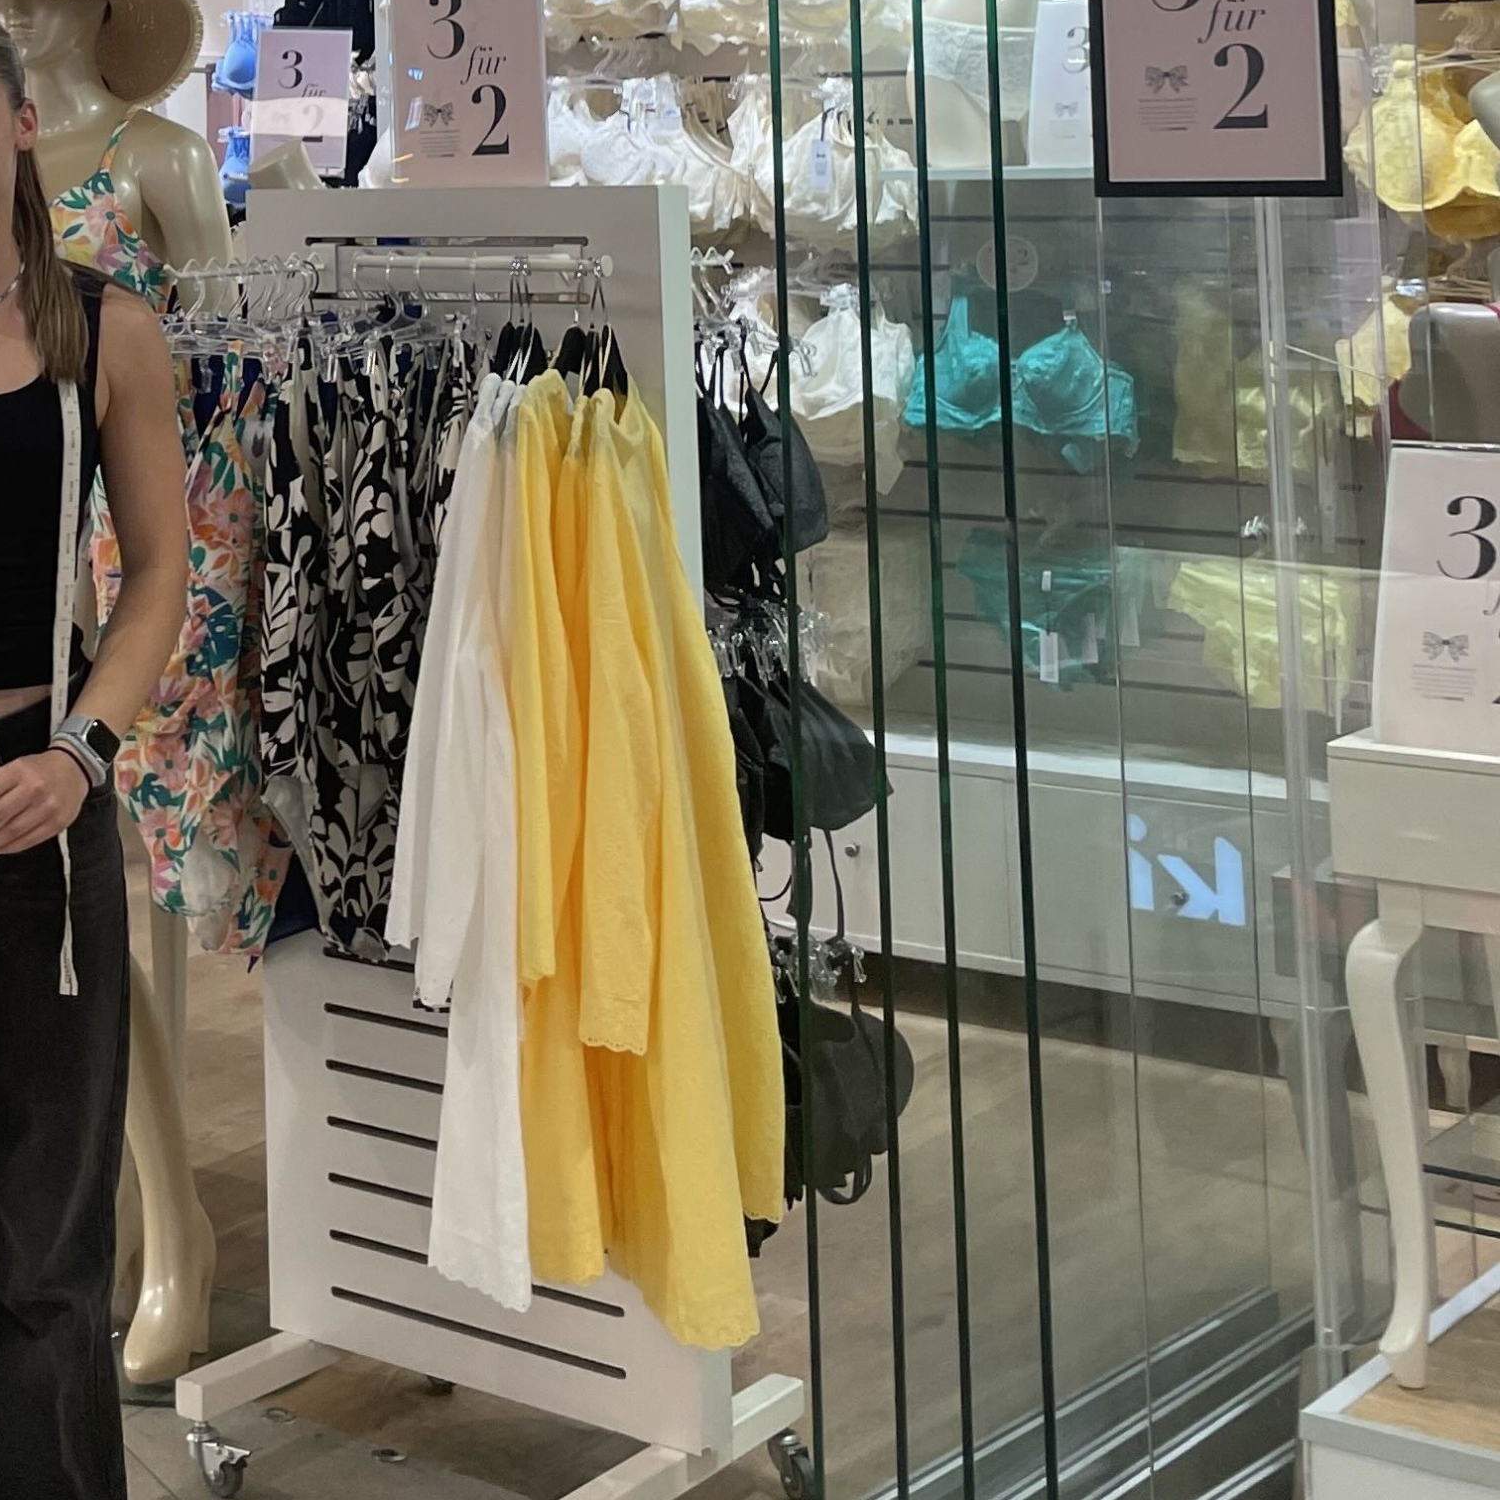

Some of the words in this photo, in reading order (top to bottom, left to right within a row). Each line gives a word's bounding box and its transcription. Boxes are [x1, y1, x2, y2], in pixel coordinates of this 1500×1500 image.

[277, 49, 304, 90] 3
[459, 45, 507, 86] für
[1213, 42, 1269, 130] 2
[302, 104, 325, 143] 2
[471, 84, 510, 156] 2
[1435, 495, 1498, 581] 3
